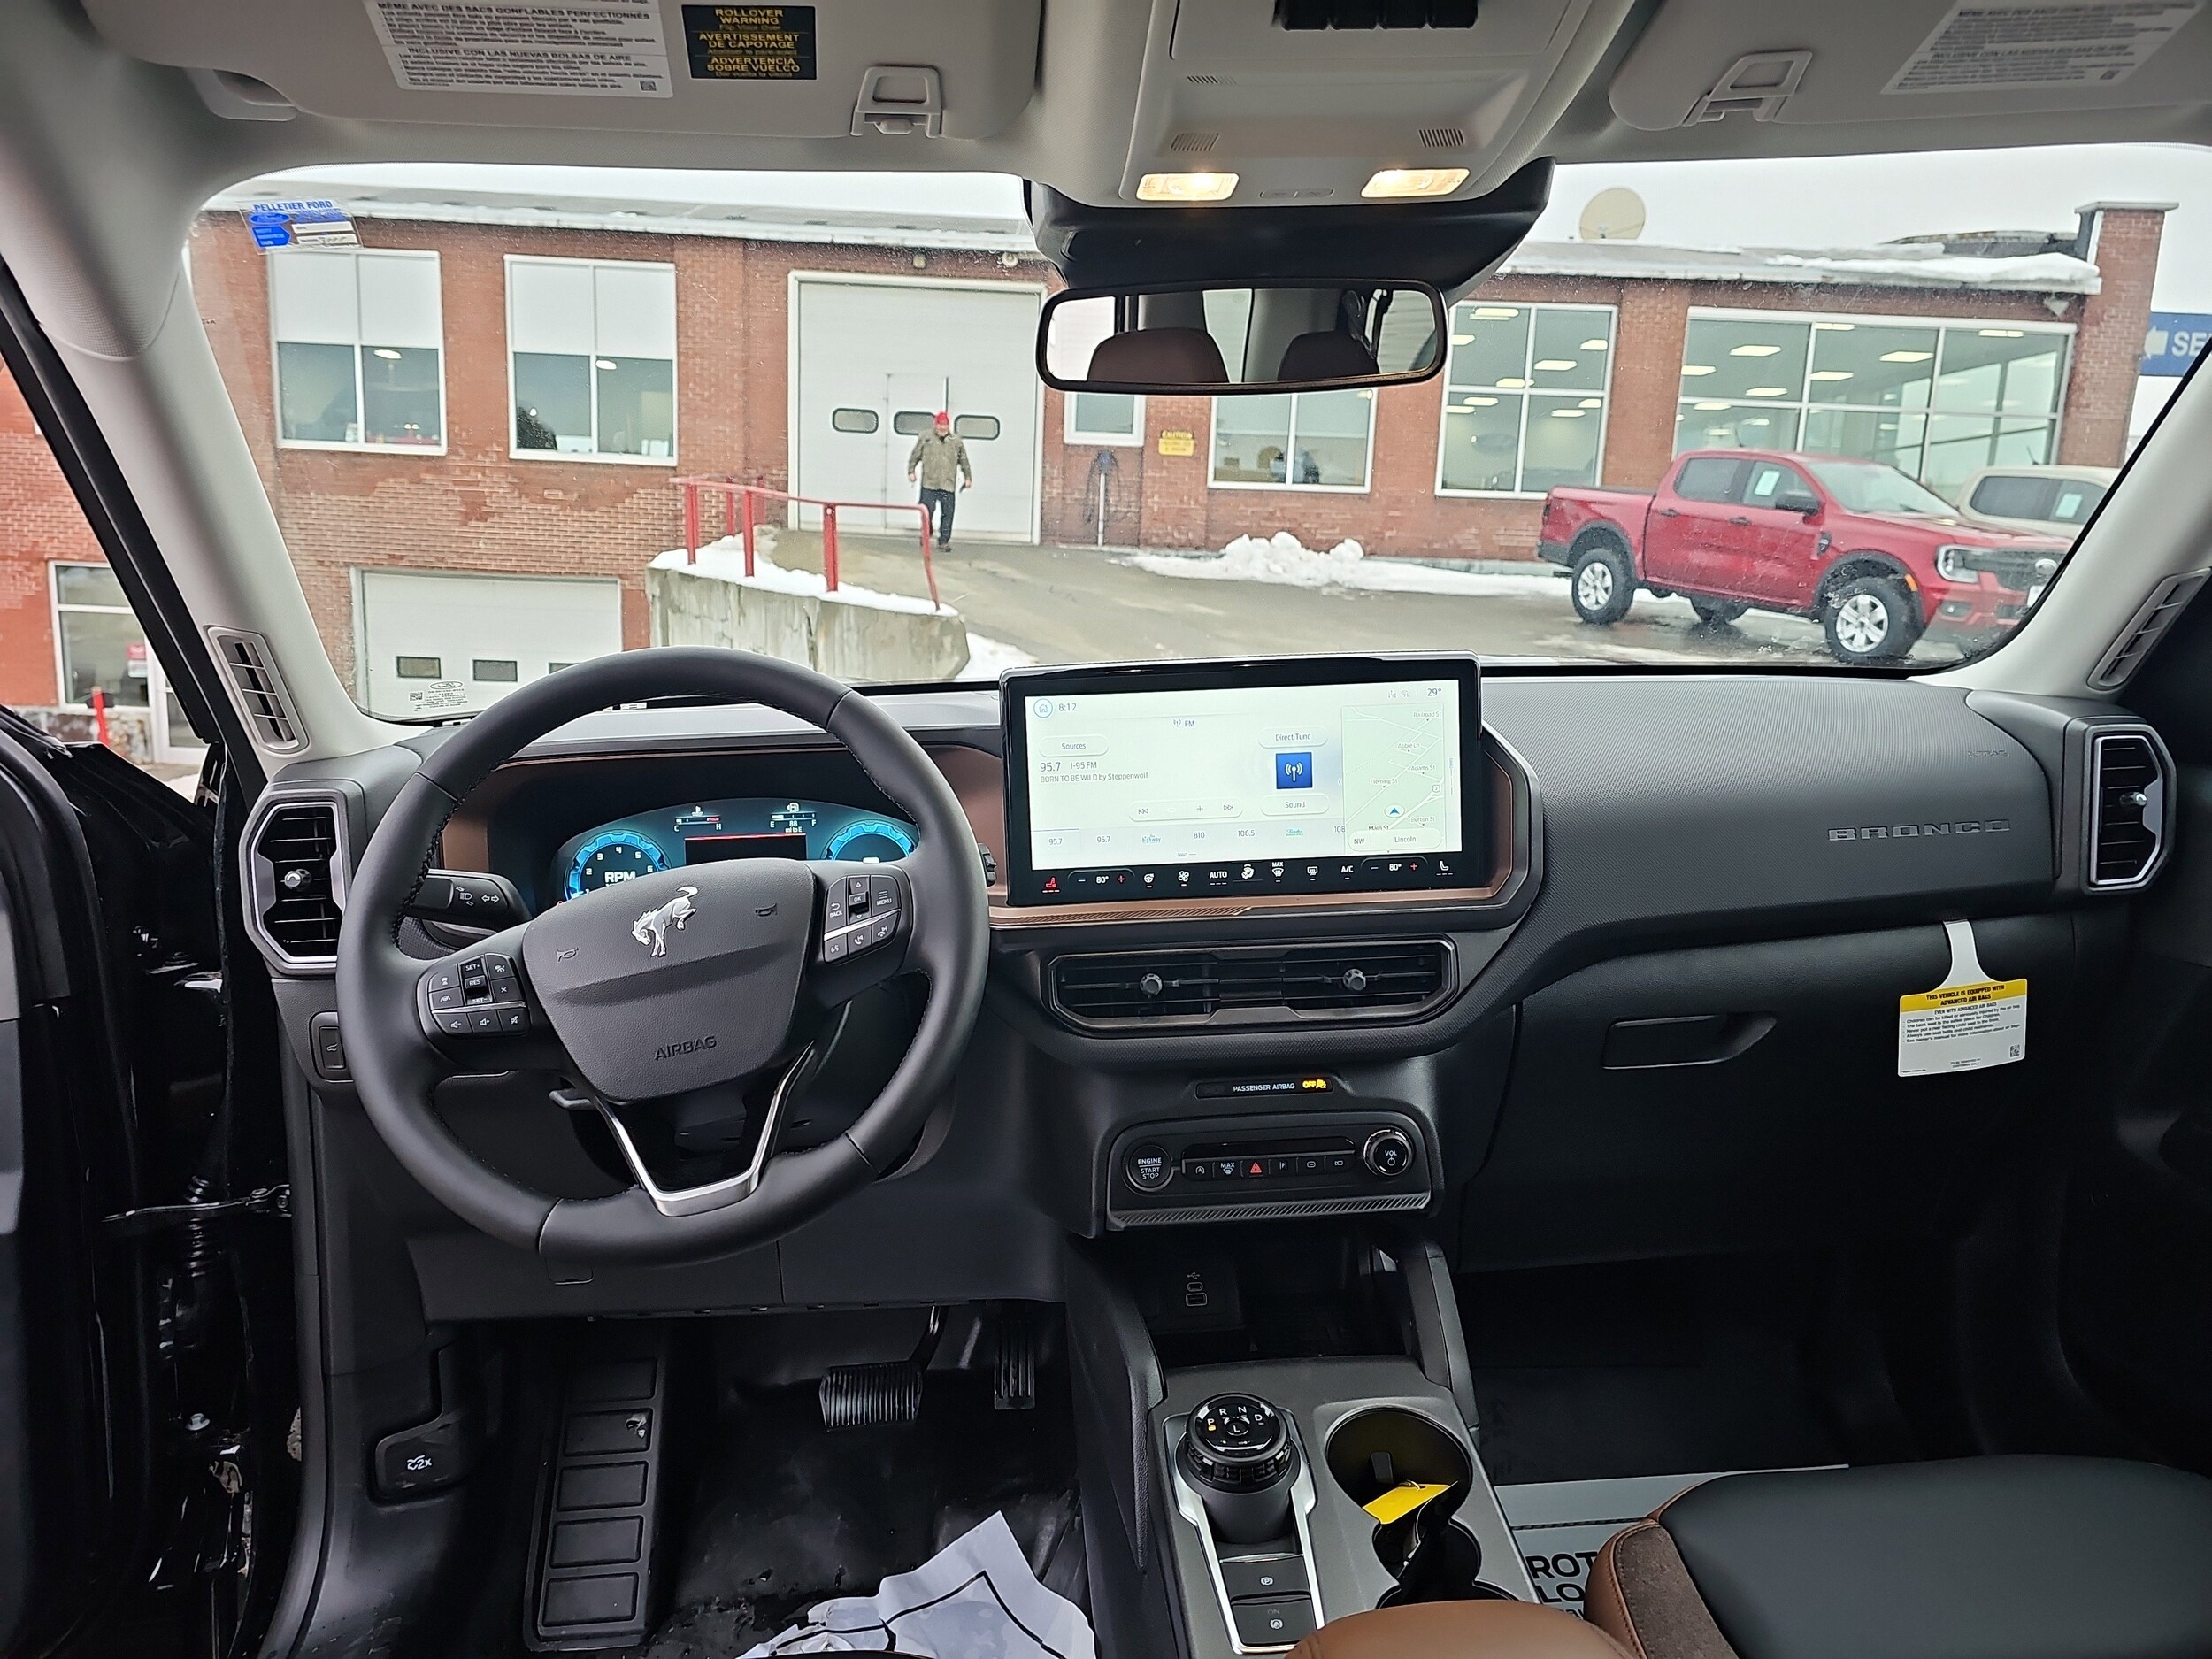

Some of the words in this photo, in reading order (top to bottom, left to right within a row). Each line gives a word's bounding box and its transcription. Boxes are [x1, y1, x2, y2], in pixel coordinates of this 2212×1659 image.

[253, 202, 304, 212] PELLETIER
[306, 200, 333, 209] FORD
[2172, 331, 2212, 357] SE
[1058, 703, 1077, 711] 8:12
[1061, 741, 1087, 750] Sources
[1040, 762, 1062, 772] 95.7
[1080, 773, 1098, 782] WILD
[1099, 773, 1106, 782] by
[1108, 772, 1148, 781] Steppenwolf
[1828, 819, 2010, 841] BRONCO
[604, 871, 636, 883] RPM
[830, 910, 843, 918] BACK
[1968, 987, 1991, 995] EQUIPPED
[655, 1035, 717, 1061] AIRBAG
[1233, 1425, 1240, 1433] L
